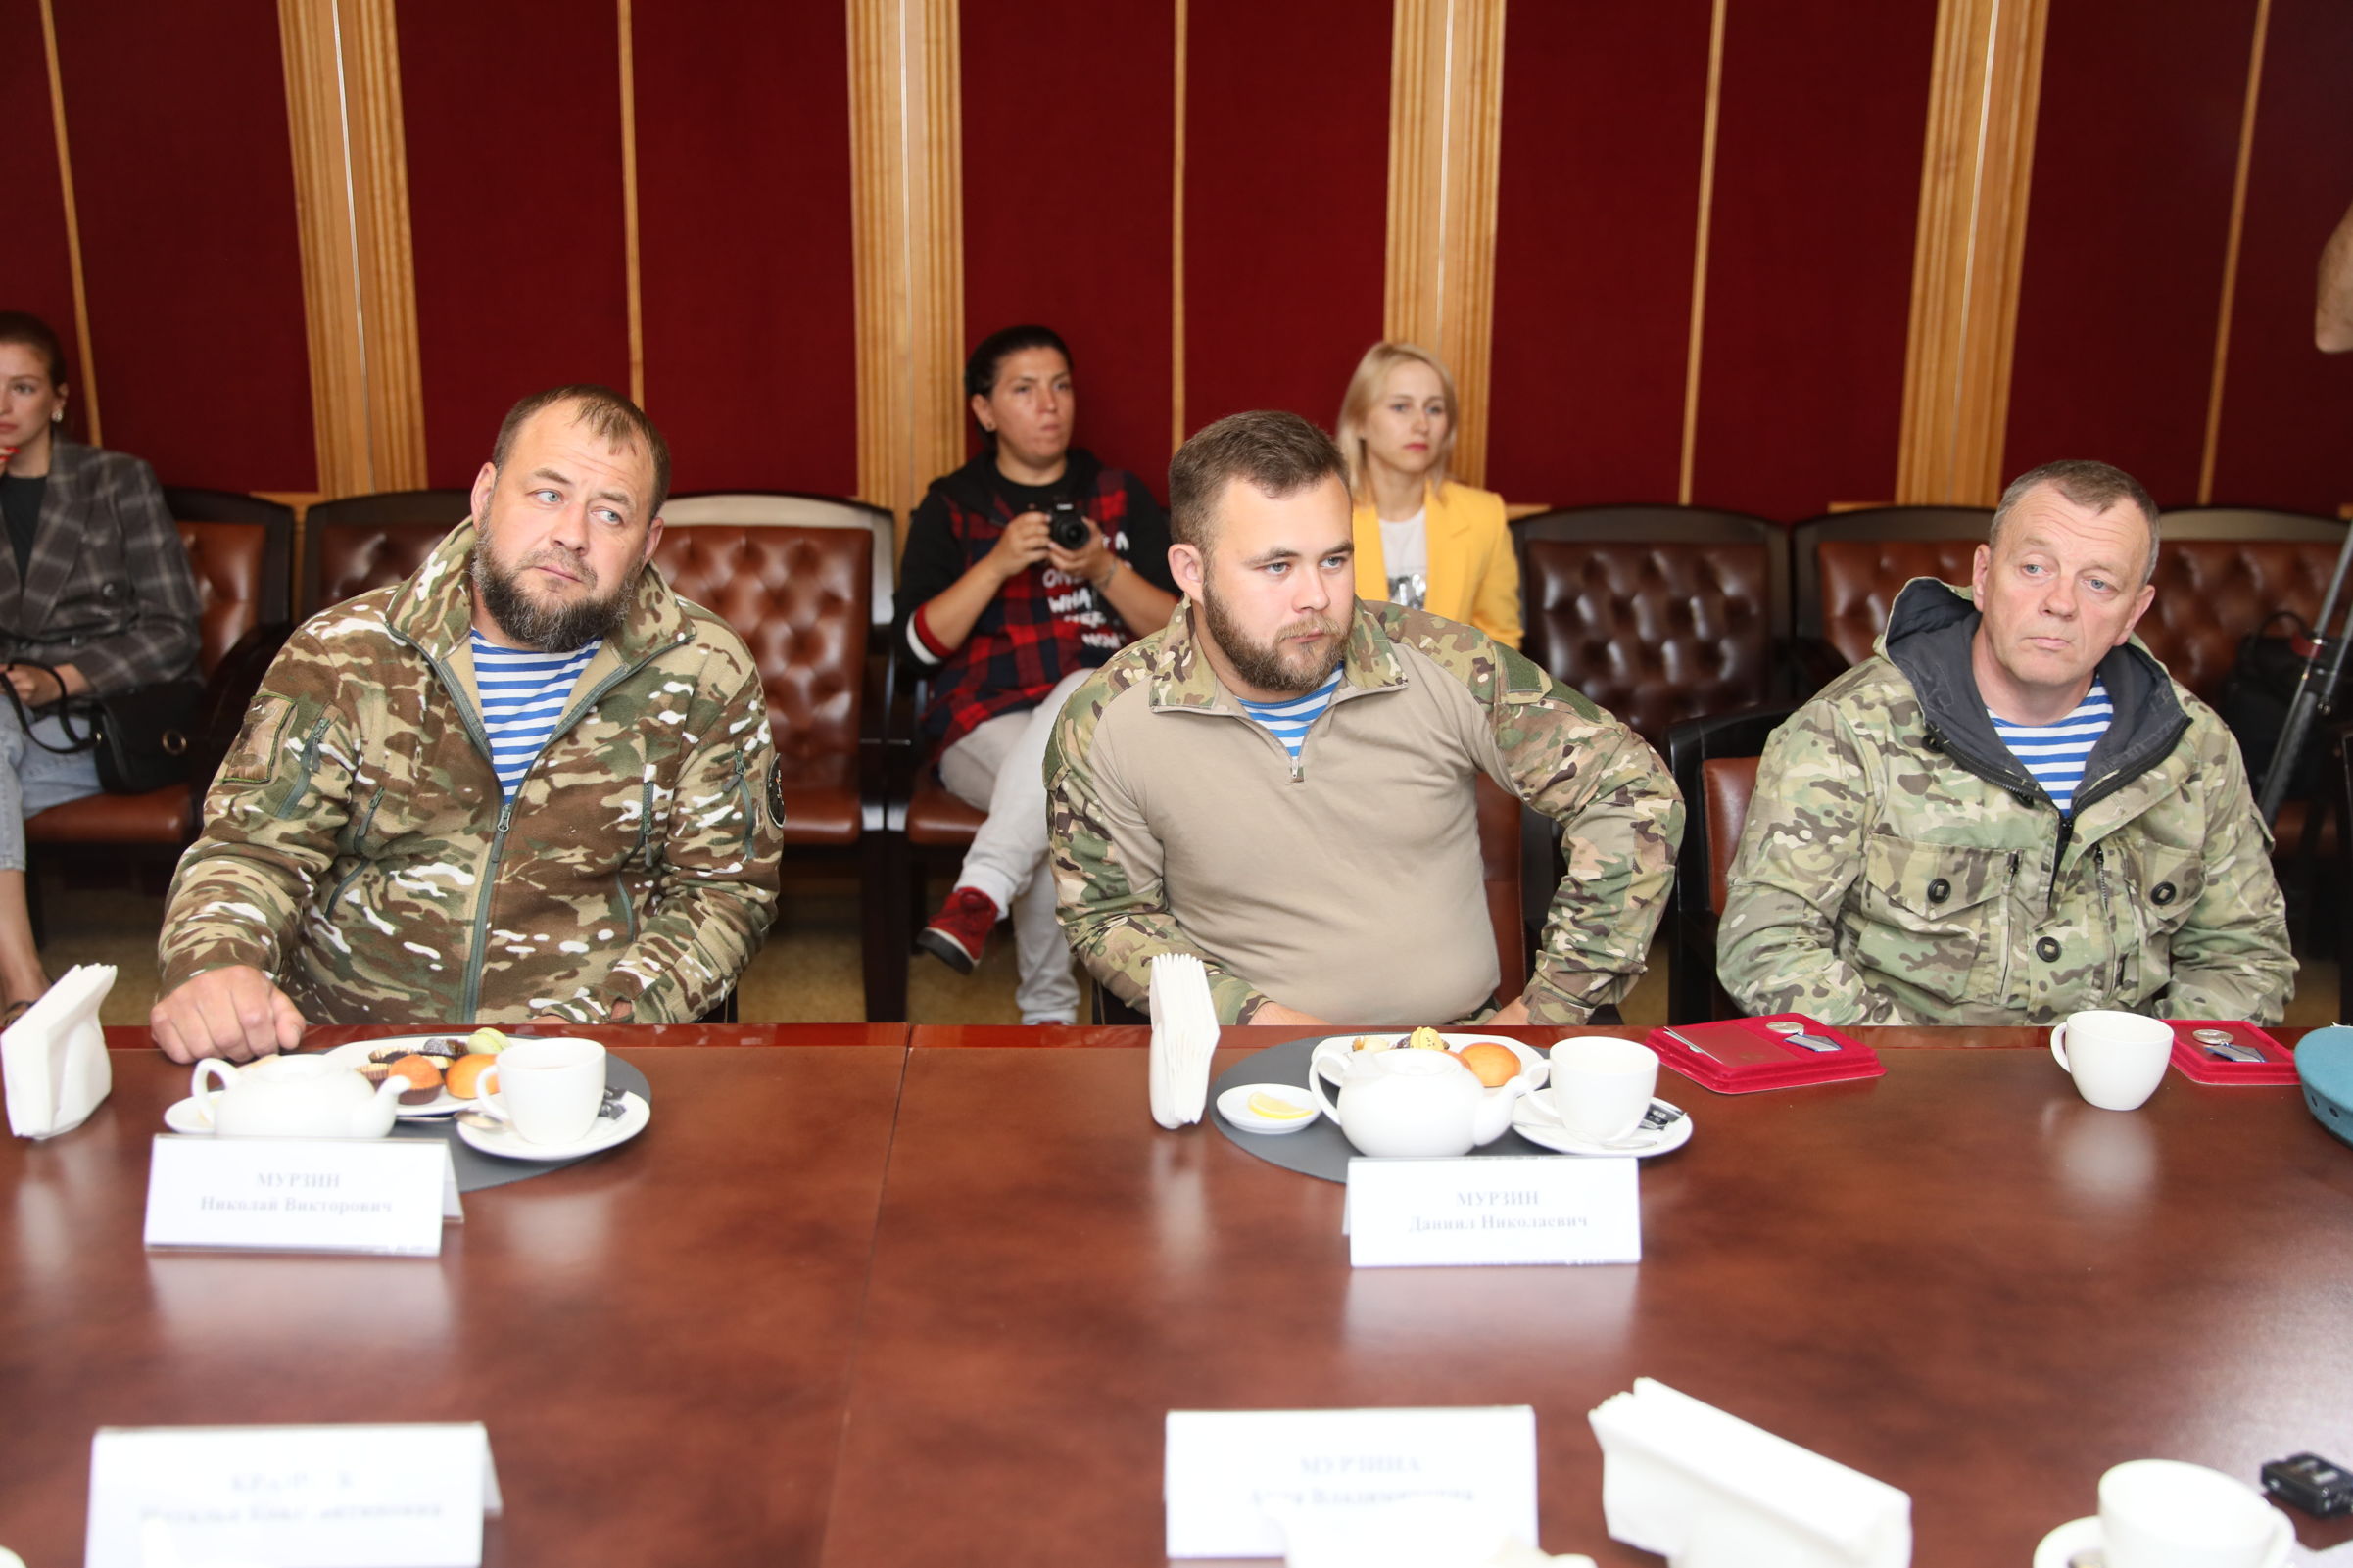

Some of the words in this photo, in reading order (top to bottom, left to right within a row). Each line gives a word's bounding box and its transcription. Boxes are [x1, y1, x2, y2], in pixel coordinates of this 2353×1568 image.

[256, 1172, 341, 1188] МУРЗИН
[200, 1195, 278, 1212] Николай
[284, 1197, 392, 1215] Викторович
[1457, 1190, 1539, 1206] МУРЗИН
[1408, 1215, 1475, 1233] Даниил
[1481, 1213, 1588, 1230] Николаевич
